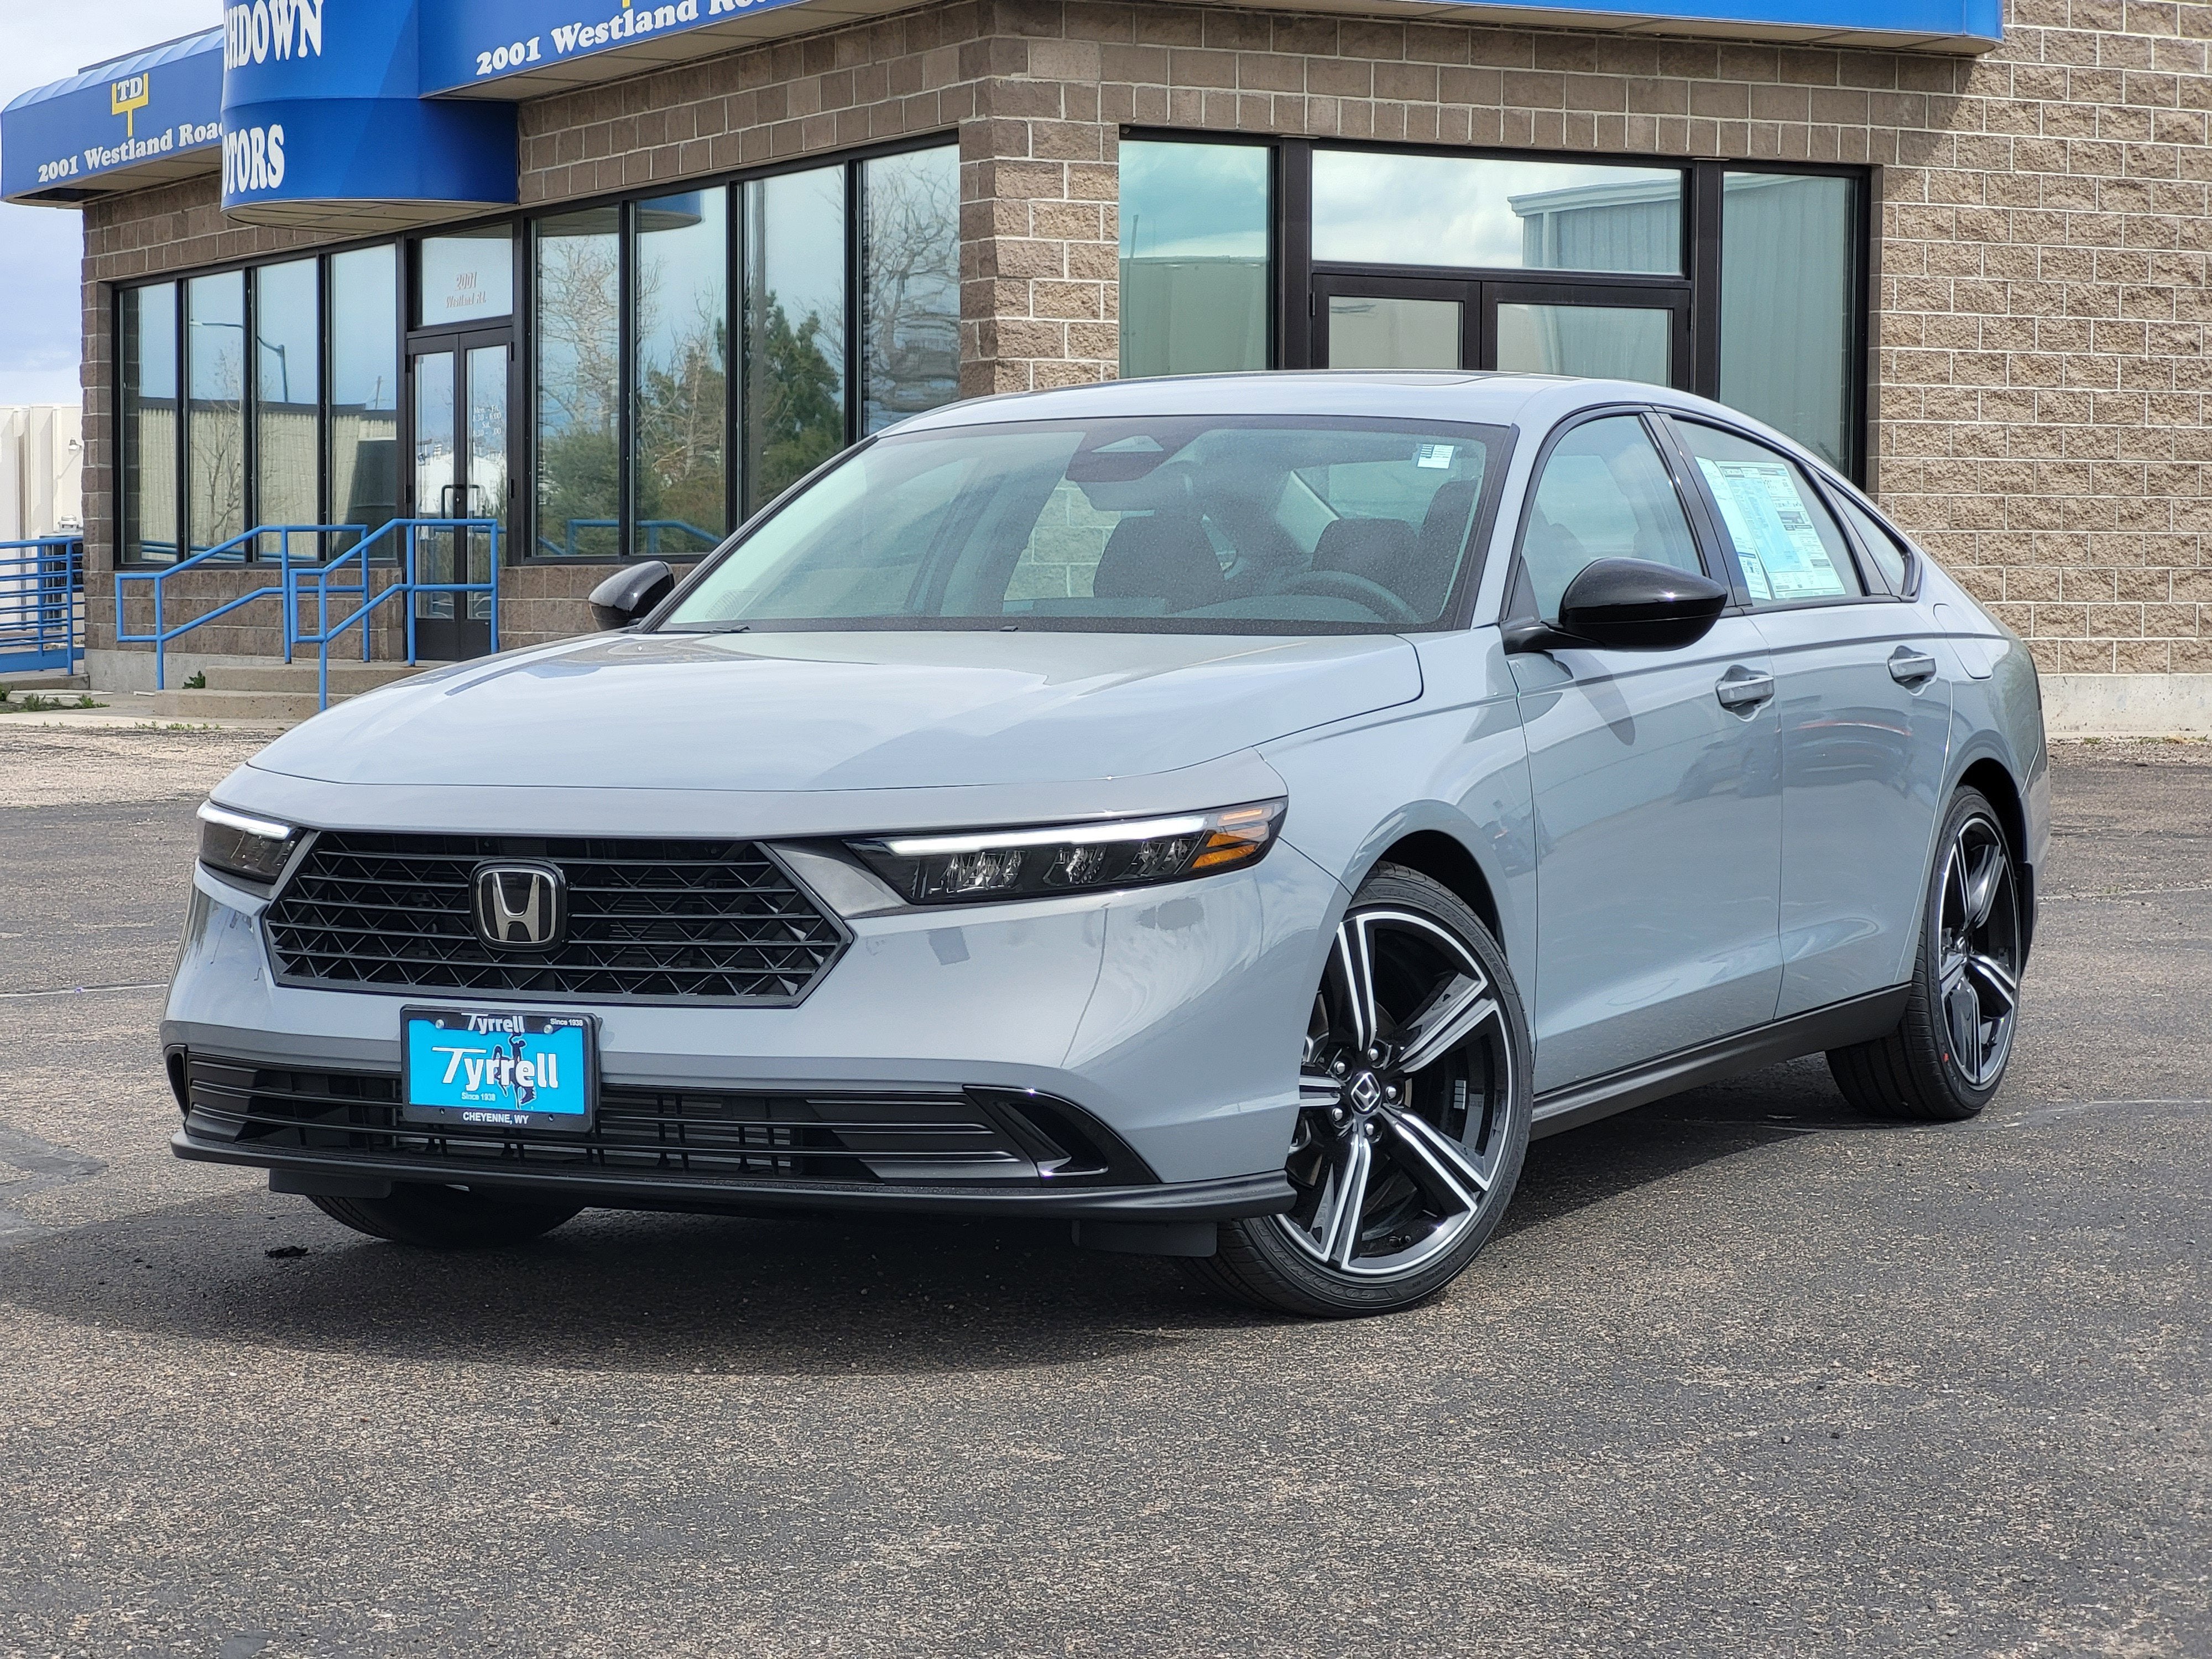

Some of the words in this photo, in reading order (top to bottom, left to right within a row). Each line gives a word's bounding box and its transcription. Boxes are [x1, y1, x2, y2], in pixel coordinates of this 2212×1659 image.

[476, 36, 541, 75] 2001
[551, 0, 698, 54] Westland
[117, 77, 143, 101] TD
[38, 155, 79, 182] 2001
[84, 128, 173, 170] Westland
[455, 271, 477, 291] 2001
[446, 292, 474, 308] Westland
[461, 1013, 525, 1035] Tyrrell
[431, 1046, 559, 1092] Tyrrell
[461, 1091, 479, 1100] Since
[462, 1112, 513, 1125] CHEYENNE,
[514, 1114, 529, 1124] WY
[1256, 1221, 1376, 1300] GOODYEAR
